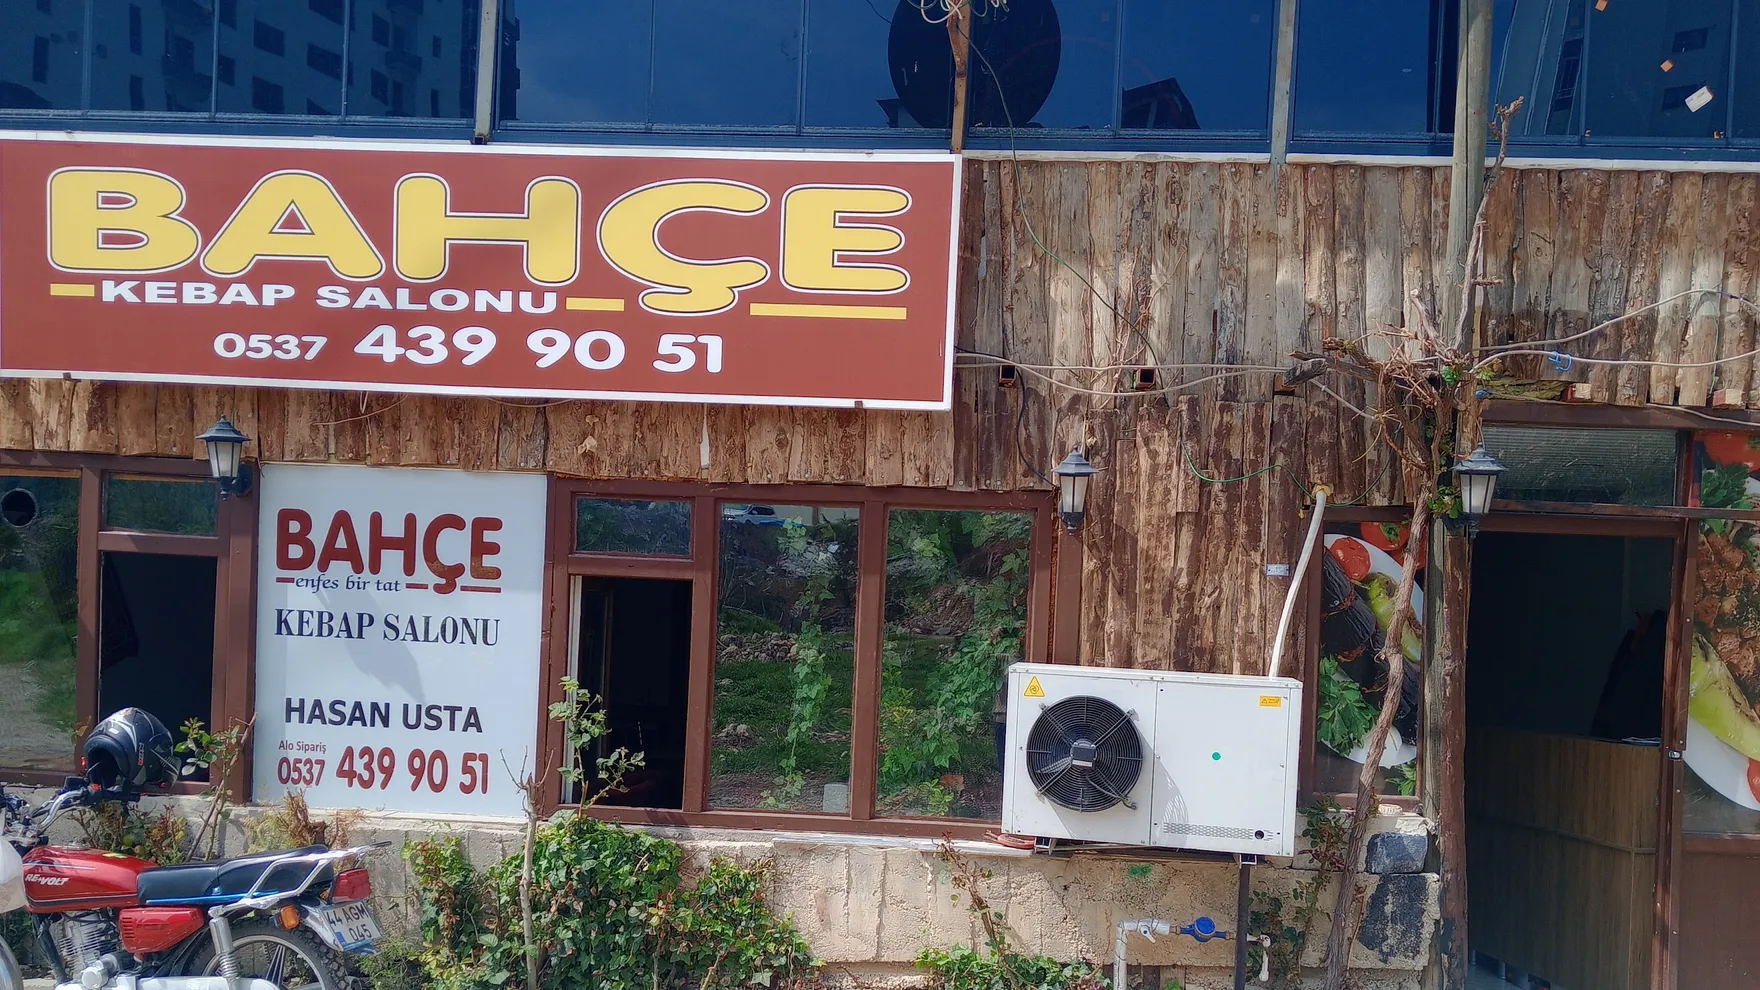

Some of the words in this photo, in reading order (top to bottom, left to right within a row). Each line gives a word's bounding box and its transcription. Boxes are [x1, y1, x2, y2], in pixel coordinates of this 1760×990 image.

[47, 166, 912, 316] BAHÇE
[102, 280, 296, 307] KEBAP
[316, 285, 558, 314] SALONU
[213, 332, 328, 362] 0537
[353, 324, 497, 367] 439
[526, 328, 626, 371] 90
[652, 333, 724, 373] 51
[275, 507, 504, 595] BAHÇE
[295, 573, 339, 593] enfes
[346, 575, 371, 591] bir
[376, 580, 401, 592] tat
[274, 608, 375, 640] KEBAP
[383, 613, 501, 646] SALONU
[284, 697, 391, 728] HASAN
[402, 703, 483, 733] USTA
[278, 740, 294, 751] Alo
[296, 740, 327, 754] Sipariş
[277, 756, 326, 787] 0537
[335, 745, 396, 790] 439
[407, 748, 449, 793] 90
[459, 752, 489, 795] 51
[326, 909, 343, 926] 44
[342, 903, 369, 922] AGM
[348, 924, 372, 941] 045
